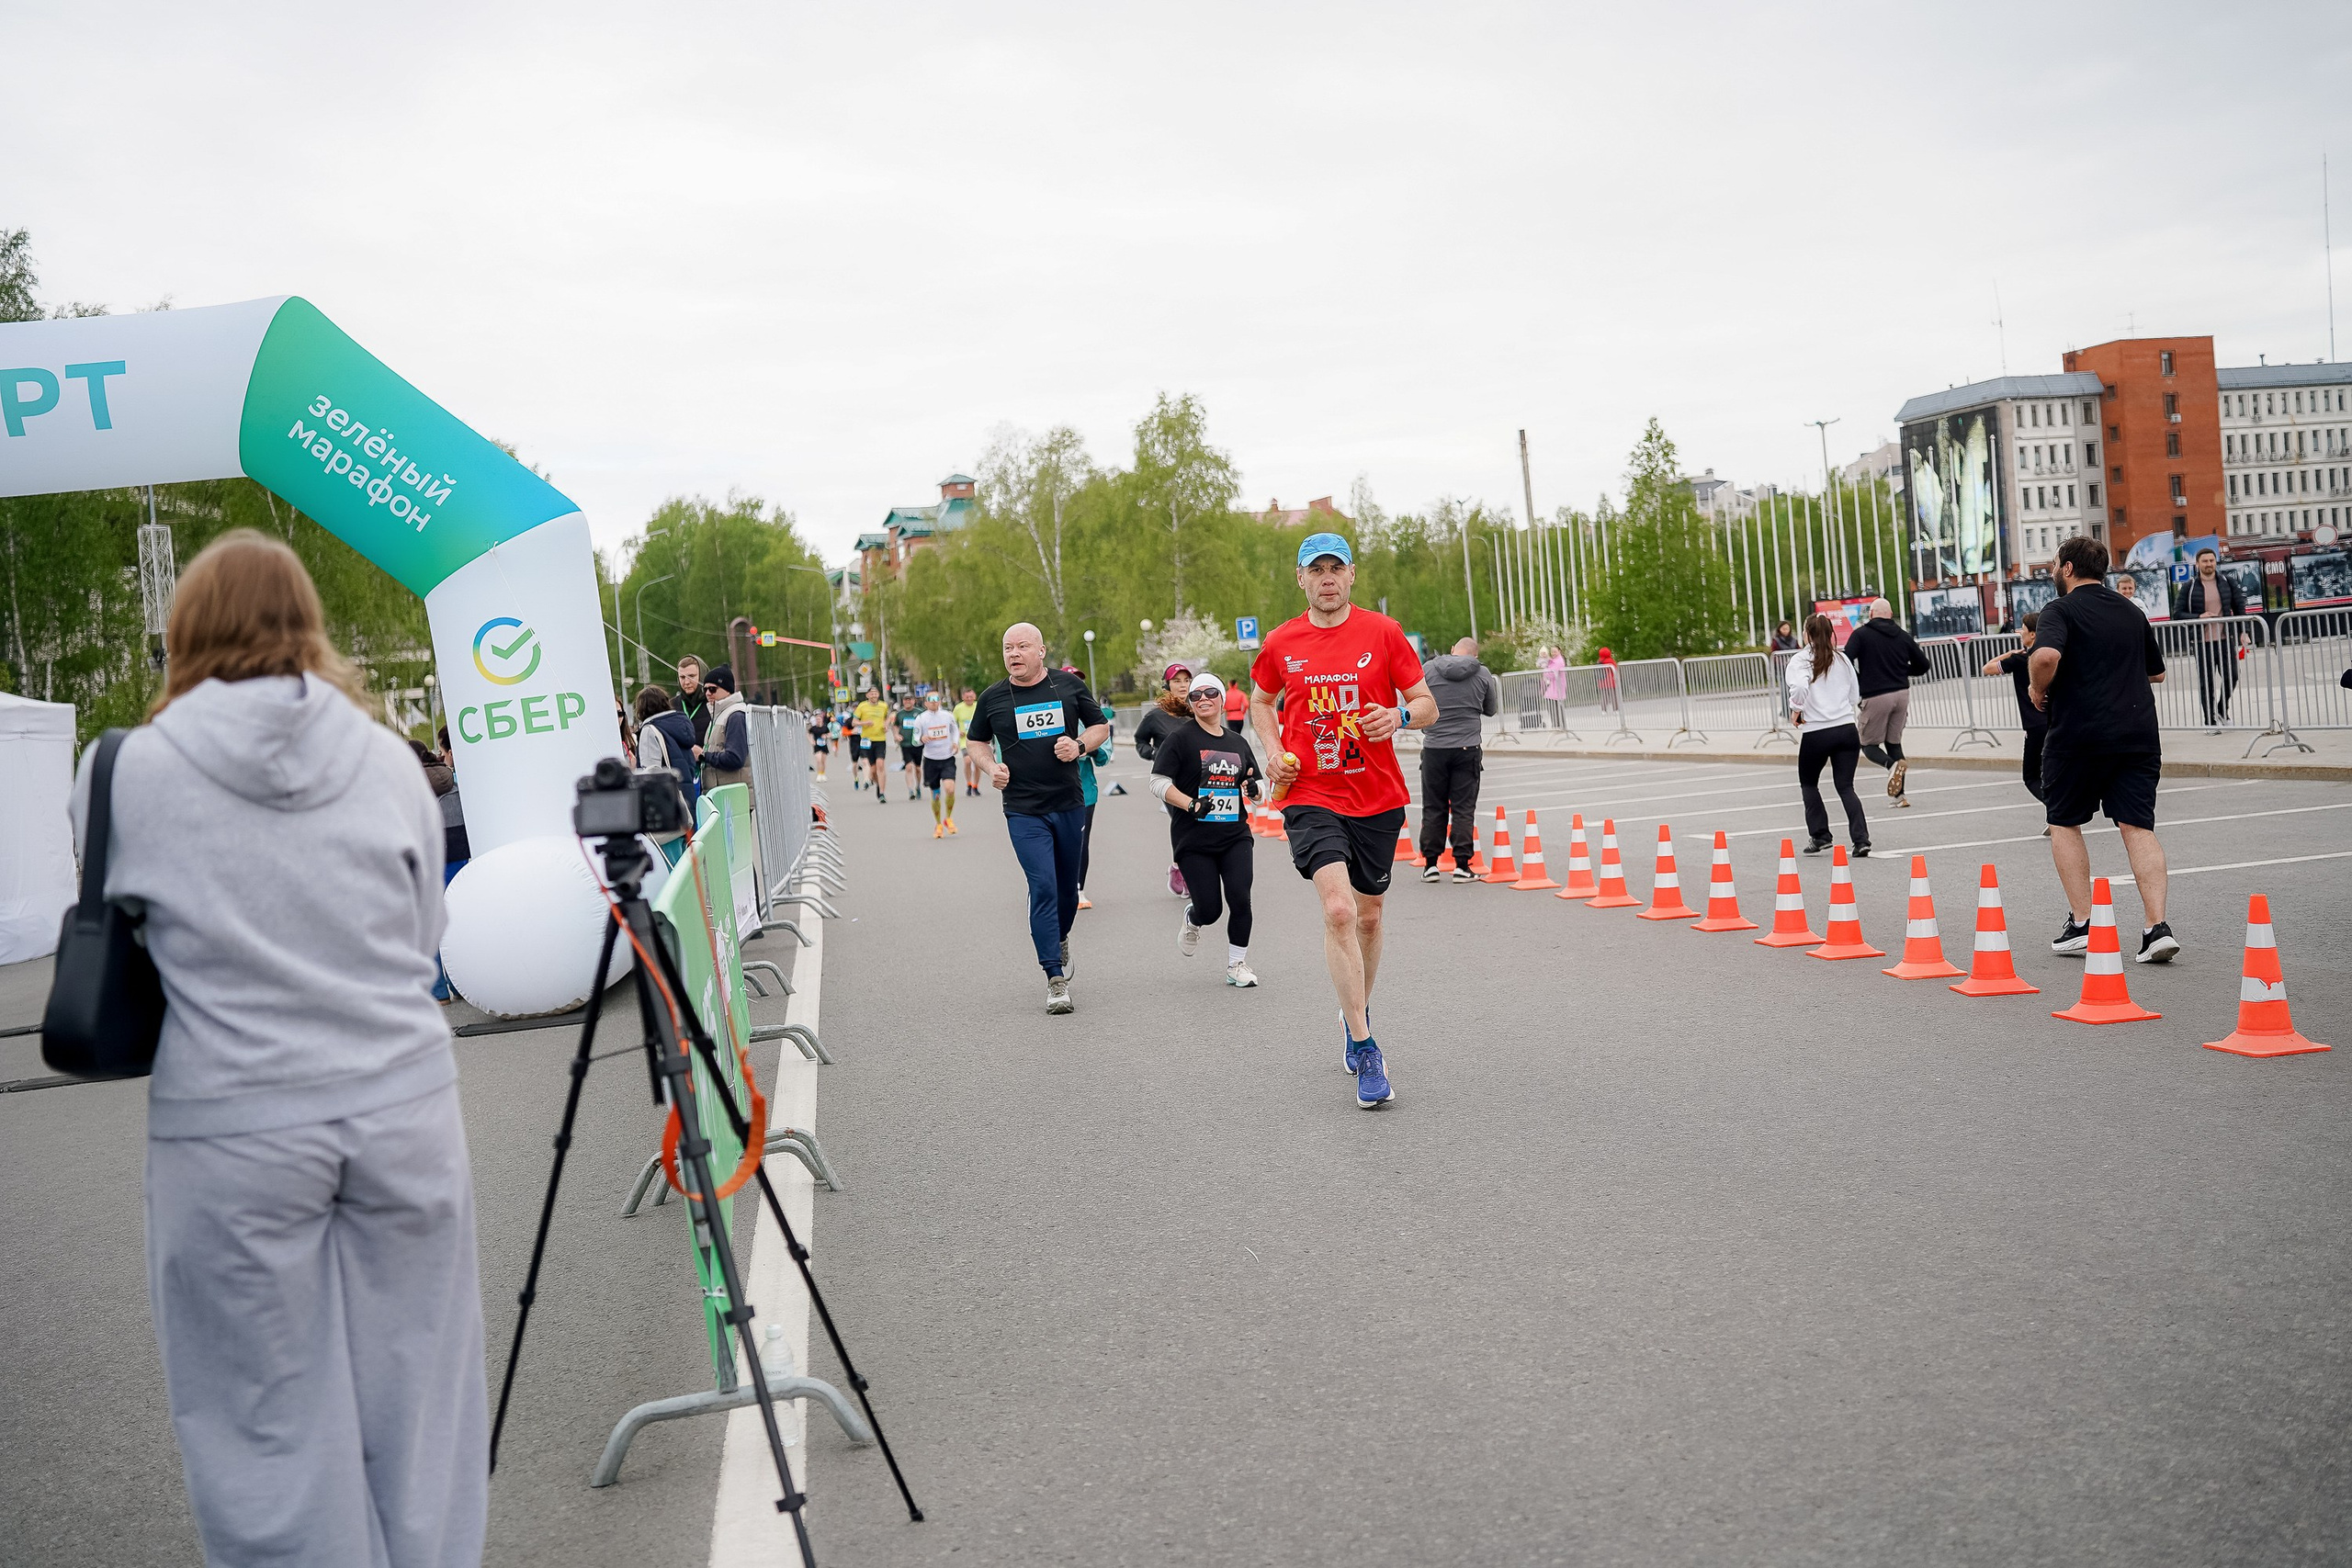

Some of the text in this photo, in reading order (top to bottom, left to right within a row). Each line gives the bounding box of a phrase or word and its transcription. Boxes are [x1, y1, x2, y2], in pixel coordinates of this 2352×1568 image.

[0, 360, 126, 437] РТ
[308, 394, 458, 507] зелёный
[287, 419, 432, 533] марафон
[2175, 565, 2187, 581] P
[1242, 621, 1253, 637] P
[1304, 672, 1359, 684] МАРАФОН
[458, 692, 586, 744] СБЕР
[1026, 712, 1055, 728] 652
